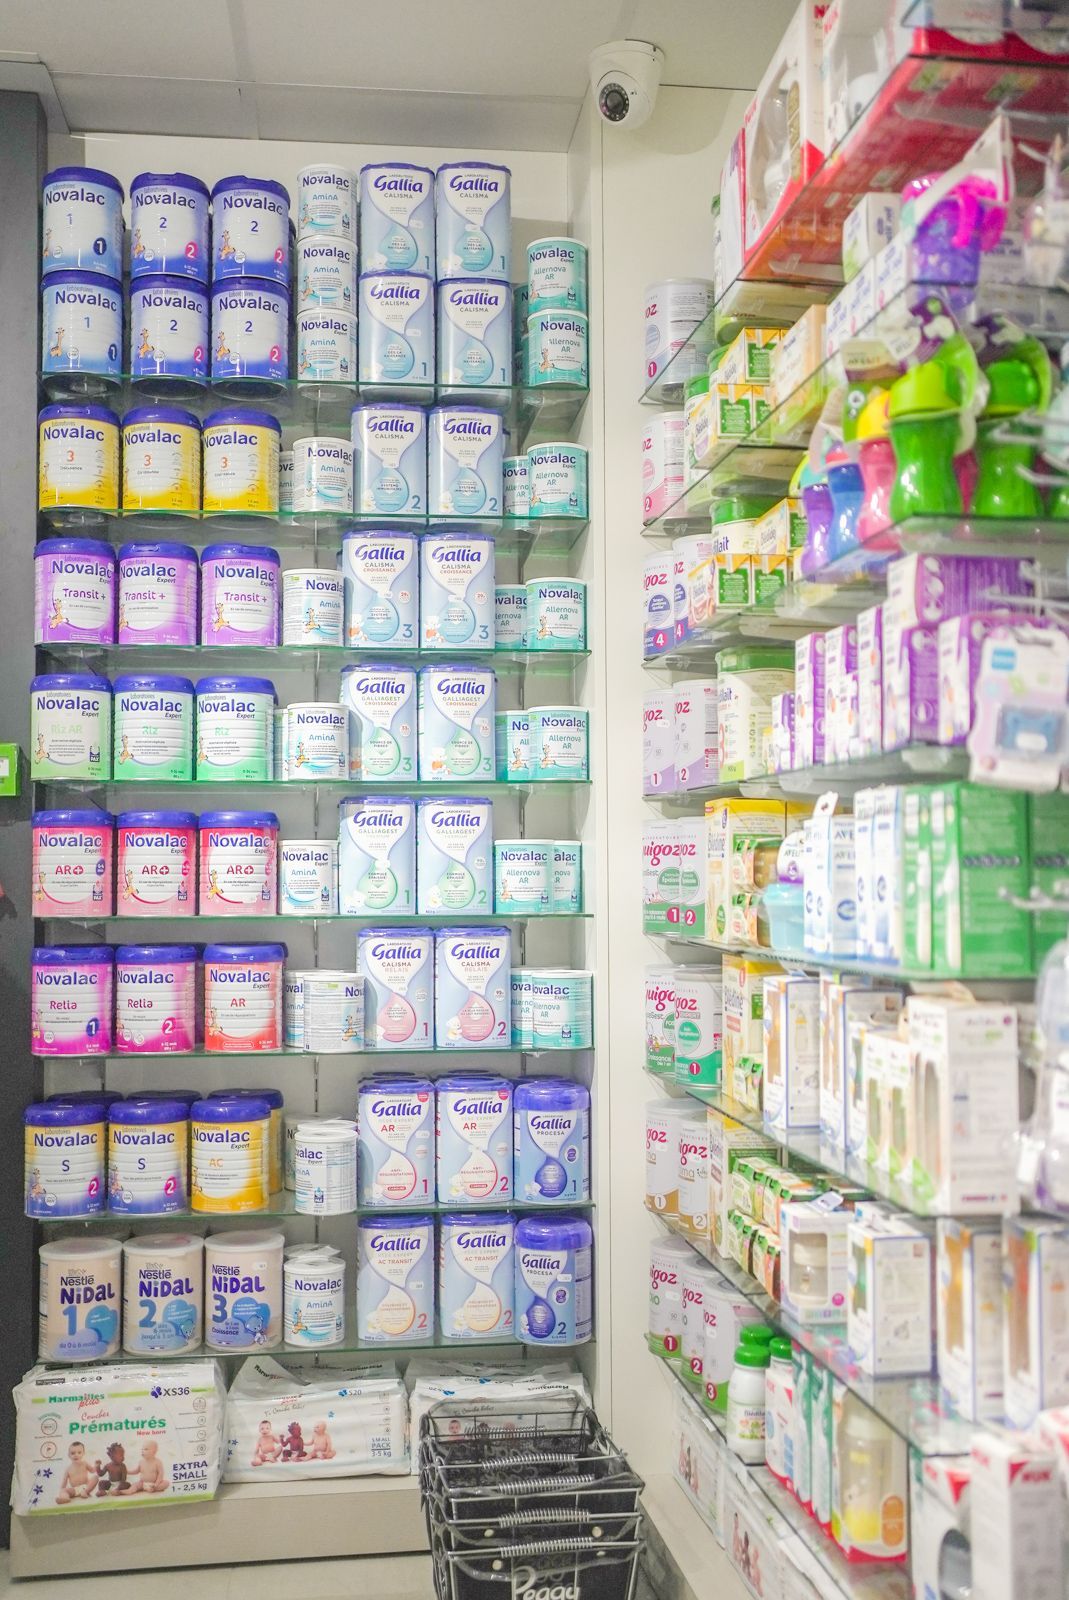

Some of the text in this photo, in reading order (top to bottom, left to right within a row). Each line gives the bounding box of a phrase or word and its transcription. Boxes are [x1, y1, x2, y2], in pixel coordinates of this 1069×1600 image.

[302, 174, 350, 188] Novalac
[373, 175, 423, 193] Gallia
[449, 175, 499, 193] Gallia
[45, 188, 105, 206] Novalac
[135, 191, 196, 209] Novalac
[223, 196, 283, 215] Novalac
[66, 213, 73, 225] 1
[159, 217, 167, 229] 2
[96, 241, 103, 254] 1
[187, 244, 195, 259] 2
[303, 247, 350, 260] Novalac
[55, 290, 117, 312] Novalac
[142, 294, 203, 313] Novalac
[219, 296, 280, 313] Novalac
[449, 289, 499, 306] Gallia
[367, 416, 415, 433] Gallia
[43, 425, 105, 441] Novalac
[124, 429, 182, 447] Novalac
[66, 450, 75, 462] 3
[143, 455, 152, 466] 3
[530, 453, 577, 467] Novalac
[355, 544, 405, 560] Gallia
[431, 547, 481, 563] Gallia
[121, 563, 176, 578] Novalac
[214, 565, 275, 582] Novalac
[62, 588, 99, 600] Transit
[125, 590, 156, 601] Transit
[223, 592, 260, 603] Transit
[656, 633, 664, 646] 4
[356, 678, 406, 695] Gallia
[437, 679, 486, 695] Gallia
[37, 696, 100, 711] Novalac
[121, 698, 183, 713] Novalac
[198, 698, 256, 714] Novalac
[681, 768, 687, 781] 2
[353, 811, 403, 827] Gallia
[431, 812, 481, 828] Gallia
[39, 833, 102, 847] Novalac
[125, 834, 187, 847] Novalac
[282, 851, 329, 861] Novalac
[501, 851, 548, 862] Novalac
[686, 911, 694, 925] 2
[371, 943, 422, 960] Gallia
[451, 943, 500, 960] Gallia
[36, 971, 98, 985] Novalac
[117, 970, 174, 984] Novalac
[210, 969, 271, 983] Novalac
[49, 1000, 77, 1010] Relia
[127, 998, 153, 1008] Relia
[230, 998, 246, 1007] AR
[692, 1063, 698, 1075] 1
[372, 1101, 422, 1117] Gallia
[453, 1099, 503, 1115] Gallia
[530, 1115, 572, 1130] Gallia
[34, 1132, 98, 1147] Novalac
[113, 1130, 175, 1145] Novalac
[193, 1129, 250, 1143] Novalac
[61, 1159, 70, 1172] S
[137, 1157, 146, 1170] S
[208, 1158, 224, 1168] AC
[695, 1215, 704, 1226] 2
[370, 1235, 421, 1252] Gallia
[456, 1232, 507, 1249] Gallia
[522, 1253, 561, 1270] Gallia
[294, 1279, 342, 1291] Novalac
[667, 1337, 673, 1350] 1
[693, 1360, 701, 1374] 2
[48, 1393, 105, 1403] Marmailles
[163, 1386, 190, 1397] XS36
[707, 1384, 715, 1400] 3
[68, 1416, 167, 1435] Prématurés
[172, 1460, 209, 1471] EXTRA
[172, 1470, 208, 1481] SMALL
[183, 1483, 197, 1493] 2,5
[197, 1482, 208, 1492] kg
